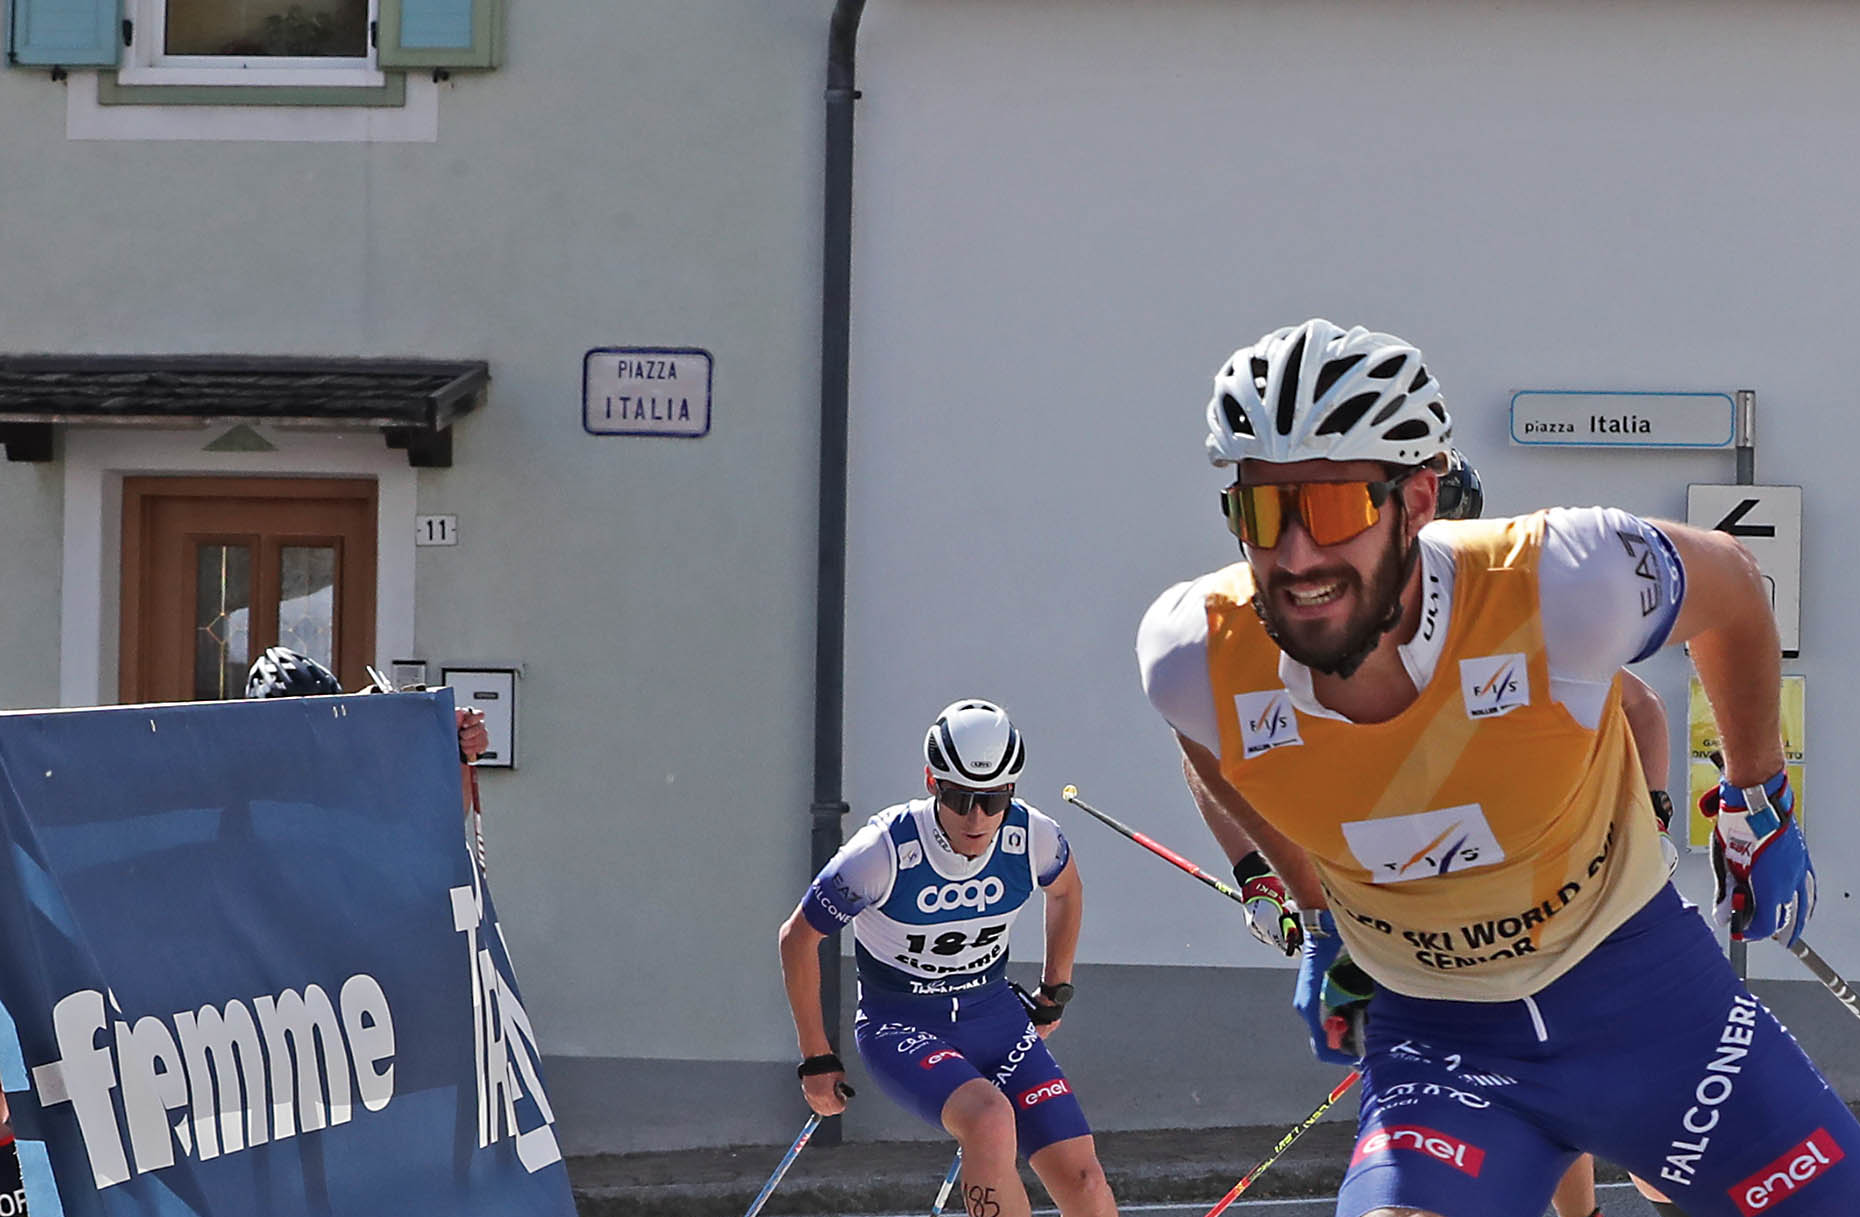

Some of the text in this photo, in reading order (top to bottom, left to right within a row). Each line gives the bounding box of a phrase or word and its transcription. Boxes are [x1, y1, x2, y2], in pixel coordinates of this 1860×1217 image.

[618, 360, 677, 380] PIAZZA
[605, 396, 690, 421] ITALIA
[1524, 414, 1652, 434] piazza Italia
[426, 519, 446, 541] 11
[916, 875, 1004, 913] coop
[1402, 930, 1454, 952] SKI
[1460, 881, 1582, 951] WORLD
[905, 922, 1007, 955] 185
[1024, 1079, 1068, 1106] enel
[1362, 1130, 1467, 1168] enel
[1745, 1140, 1831, 1209] enel
